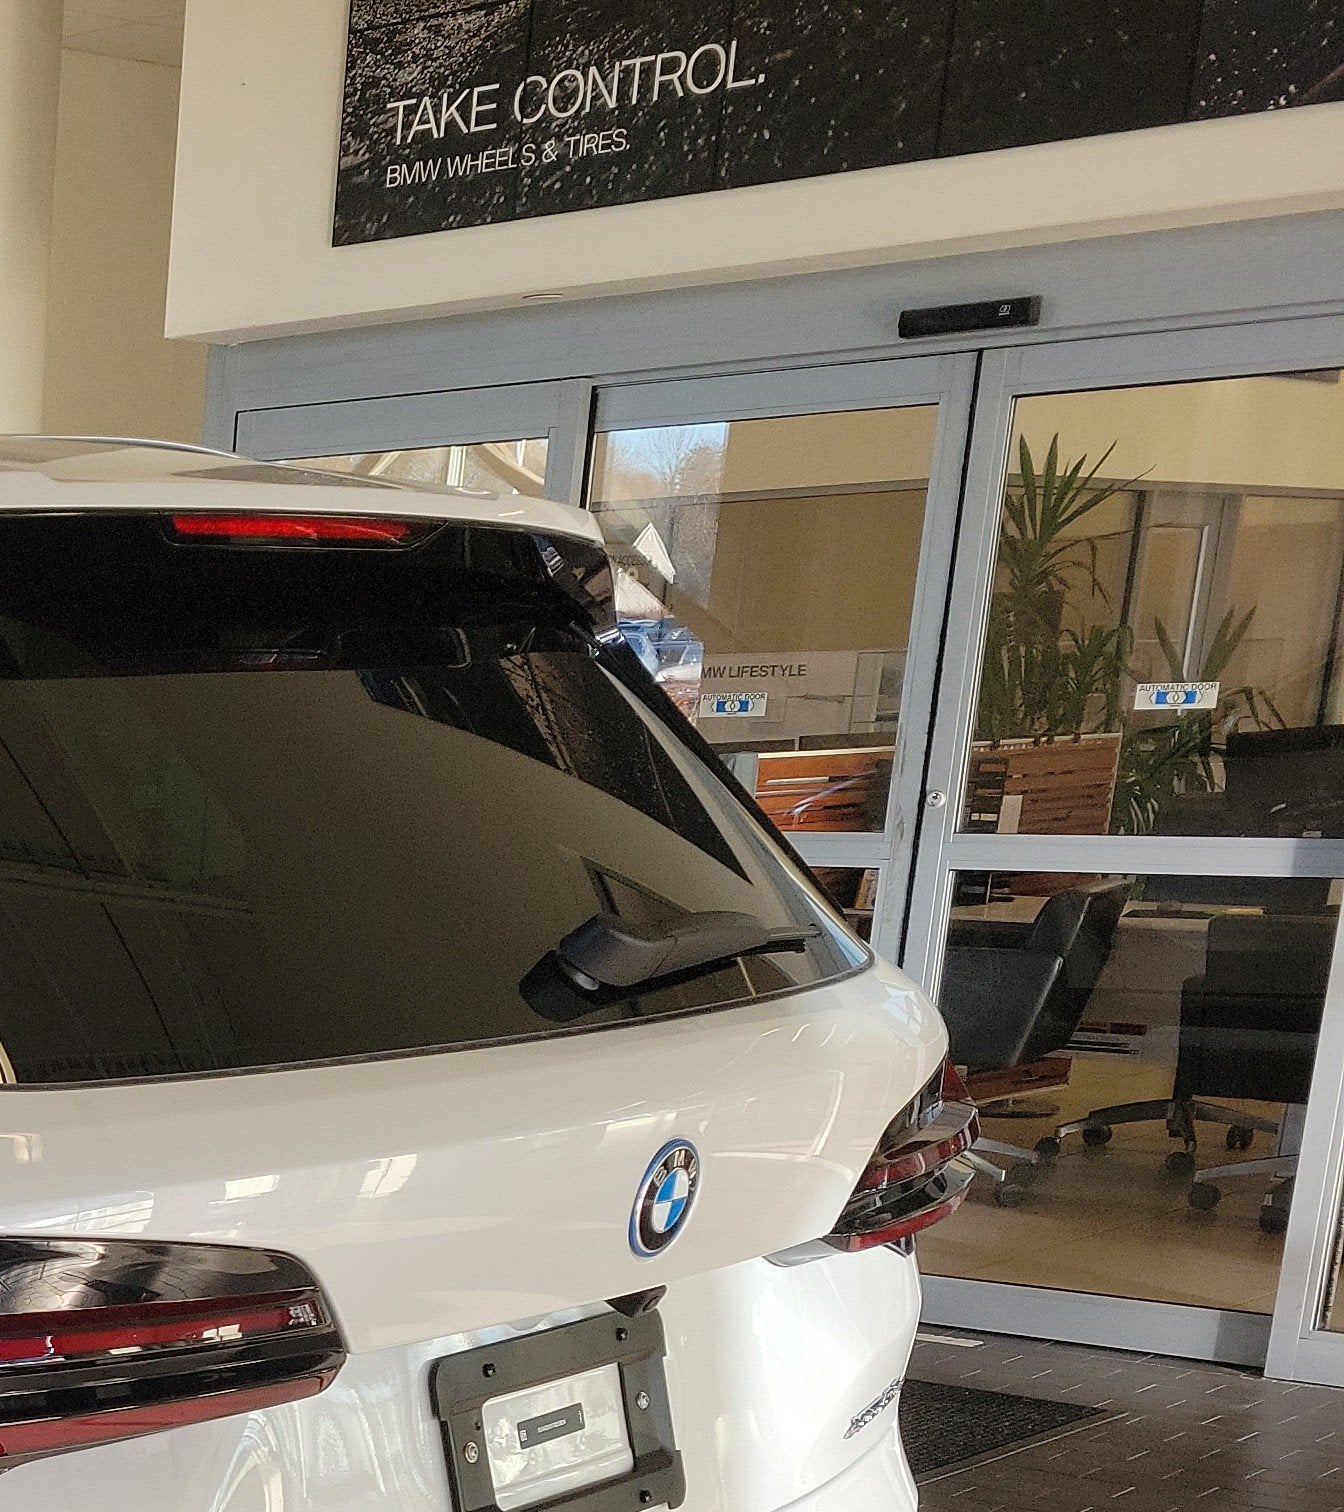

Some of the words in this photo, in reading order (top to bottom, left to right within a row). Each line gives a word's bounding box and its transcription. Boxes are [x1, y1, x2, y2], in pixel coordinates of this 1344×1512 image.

[386, 83, 500, 146] TAKE
[514, 38, 765, 124] CONTROL.
[386, 158, 442, 188] BMW
[447, 144, 536, 178] WHEELS
[542, 140, 558, 163] &
[565, 128, 631, 158] TIRES.
[701, 665, 726, 679] MW
[728, 664, 807, 679] LIFESTYLE
[1139, 683, 1188, 692] AUTOMATIC
[1192, 682, 1217, 691] DOOR
[703, 693, 743, 701] AUTOMATIC
